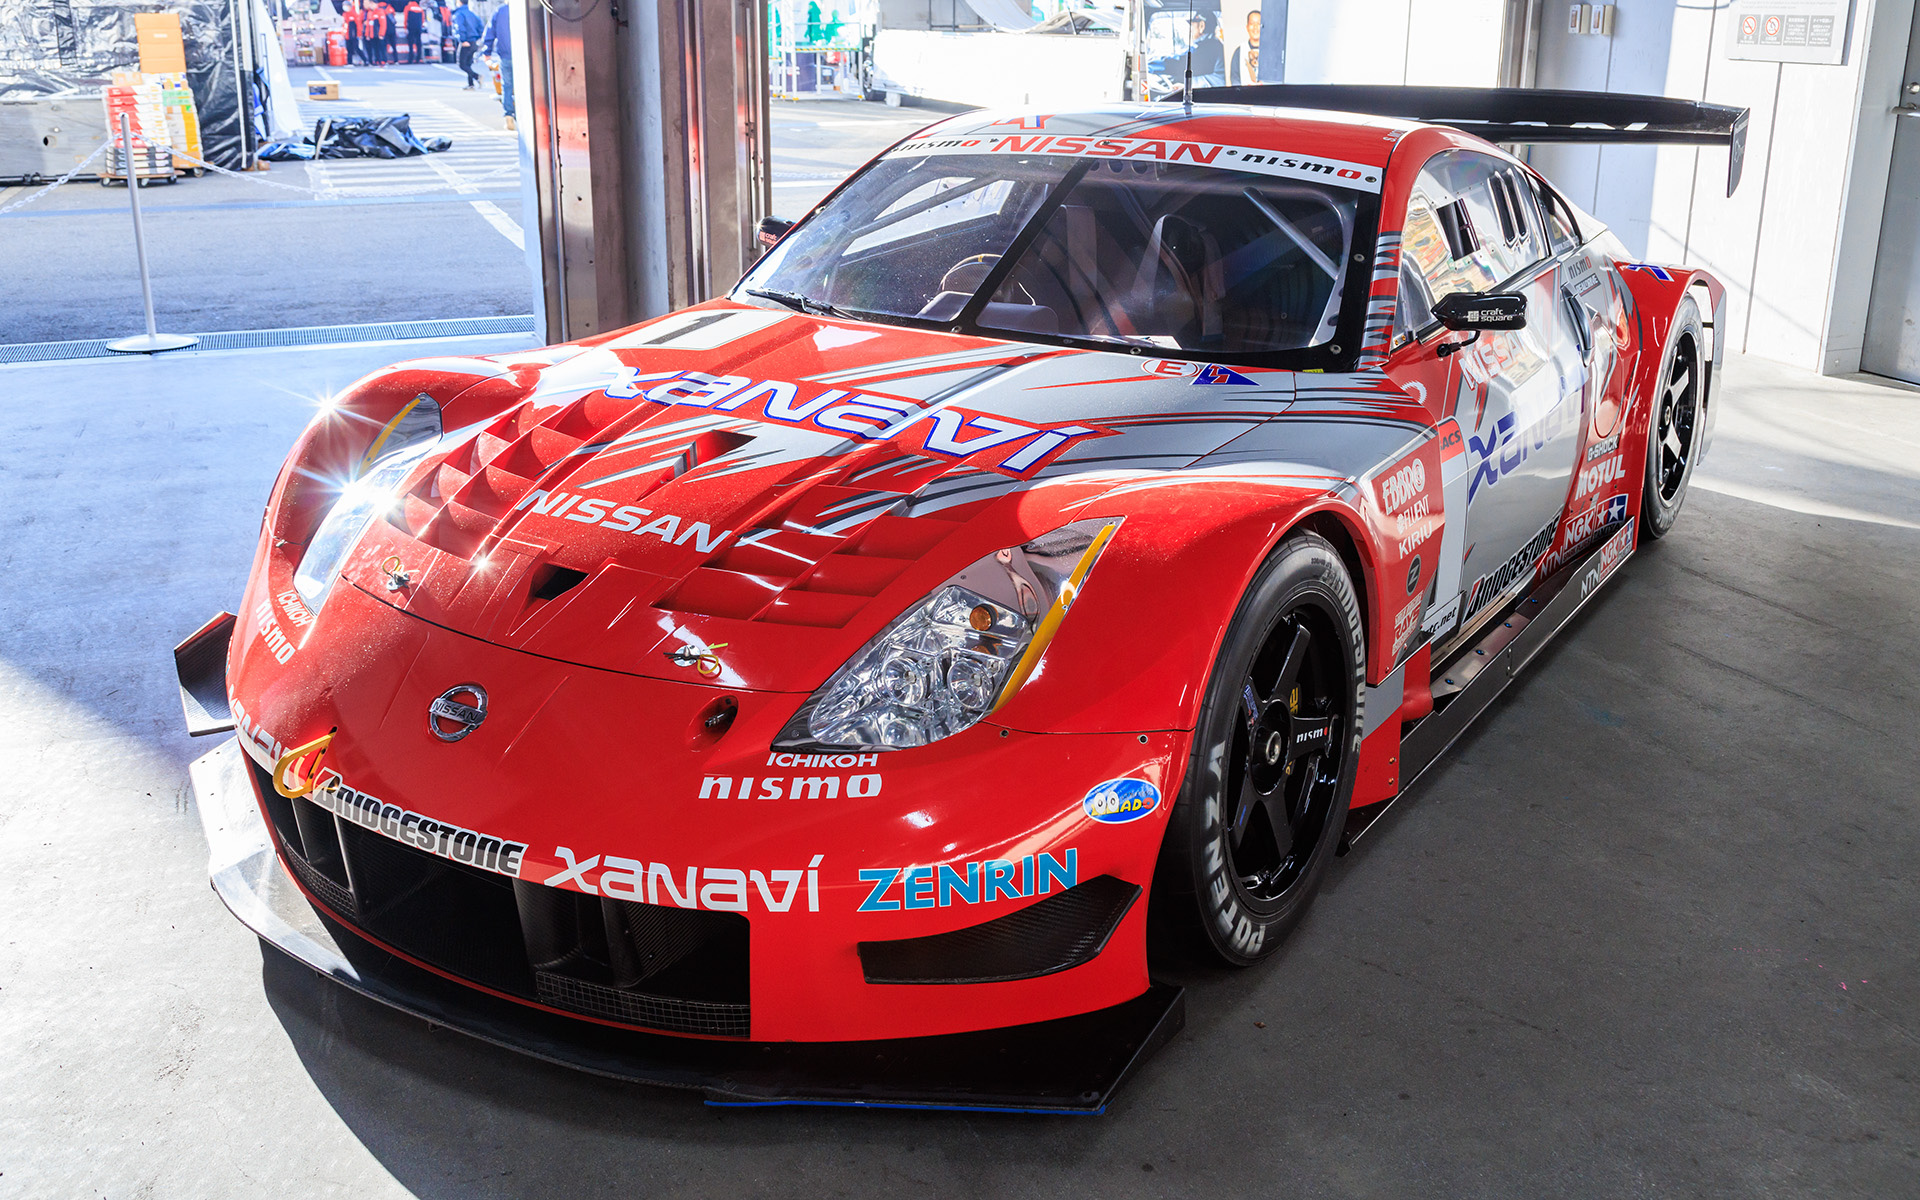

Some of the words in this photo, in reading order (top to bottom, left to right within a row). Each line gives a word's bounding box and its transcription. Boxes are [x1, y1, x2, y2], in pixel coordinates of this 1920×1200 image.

[991, 136, 1224, 164] NISSAN
[1242, 153, 1362, 180] nismo
[640, 312, 740, 345] 1
[1481, 308, 1503, 316] craft
[1154, 360, 1187, 375] E
[1458, 331, 1531, 391] NISSA
[1440, 430, 1461, 450] ACS
[1588, 435, 1619, 461] G-SHOCK
[1575, 454, 1626, 501] MOTUL
[515, 489, 733, 553] NISSAN
[1565, 511, 1594, 550] NGK
[1398, 521, 1433, 560] KIRIU
[1600, 536, 1618, 570] NGK
[1462, 515, 1560, 624] BRIDGESTONE
[1540, 546, 1563, 579] NTN
[1580, 563, 1600, 600] NTN
[276, 589, 315, 627] ICHIKOH
[255, 600, 296, 665] nismo
[433, 701, 479, 722] NISSAN
[1296, 727, 1328, 743] nismo
[766, 753, 878, 768] ICHIKOH
[698, 773, 883, 800] nismo
[313, 768, 527, 877] BRIDGESTONE
[1205, 741, 1266, 955] POTENZA
[856, 848, 1078, 912] ZENRIN
